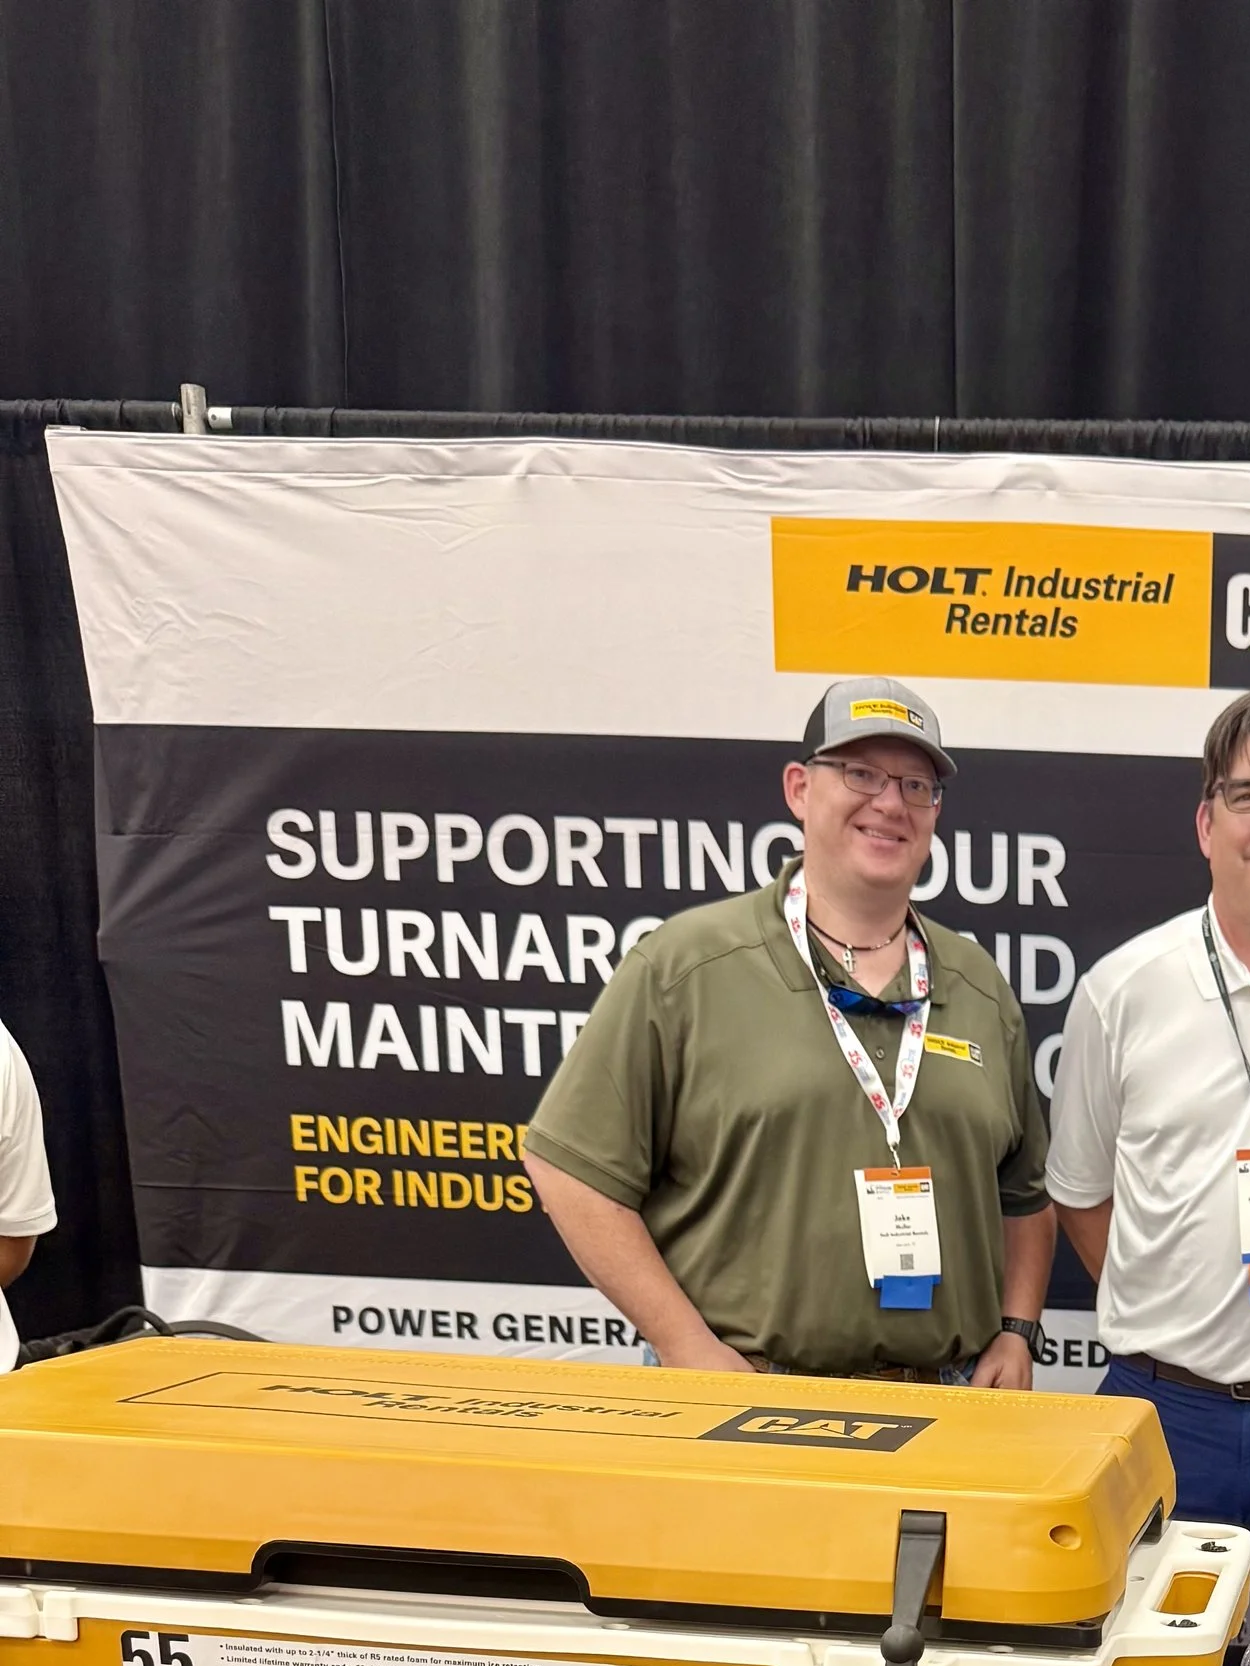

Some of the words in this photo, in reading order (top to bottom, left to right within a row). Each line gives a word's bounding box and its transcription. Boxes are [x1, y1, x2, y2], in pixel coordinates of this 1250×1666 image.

[845, 563, 992, 596] HOLT
[1003, 565, 1175, 605] Industrial
[944, 602, 1079, 640] Rentals
[264, 807, 804, 895] SUPPORTING
[293, 1165, 384, 1205] FOR
[332, 1305, 480, 1341] POWER
[258, 1384, 454, 1402] HOLT
[454, 1397, 683, 1420] Industrial
[364, 1399, 544, 1420] Rentals
[734, 1414, 900, 1441] CAT
[225, 1643, 263, 1654] Insulated
[264, 1645, 284, 1655] with
[285, 1648, 297, 1657] up
[298, 1648, 308, 1656] to
[337, 1650, 358, 1660] thick
[359, 1652, 368, 1660] of
[383, 1654, 405, 1663] rated
[406, 1655, 428, 1664] foam
[430, 1656, 442, 1665] for
[226, 1655, 258, 1665] Limited
